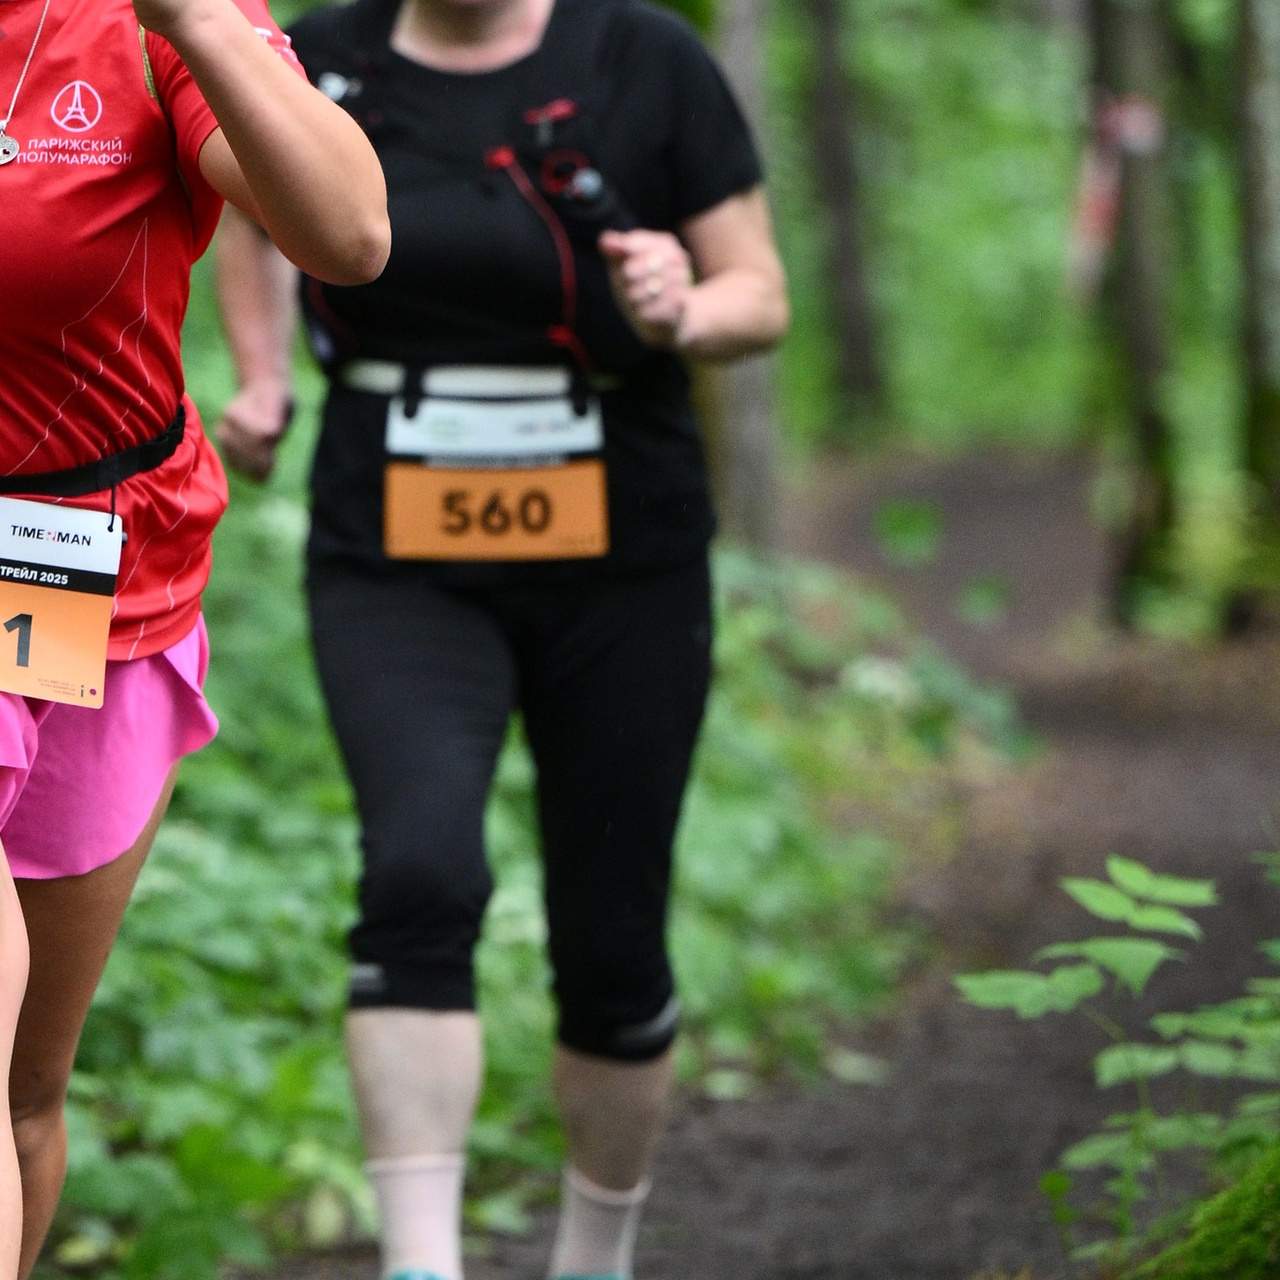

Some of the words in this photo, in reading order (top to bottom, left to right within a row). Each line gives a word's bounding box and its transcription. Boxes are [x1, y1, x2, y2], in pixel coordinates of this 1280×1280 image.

[28, 137, 122, 151] ПАРИЖСКИЙ
[17, 151, 132, 165] ПОЛУМАРАФОН
[440, 489, 552, 537] 560
[0, 565, 38, 581] ТРЕЙЛ
[39, 571, 68, 585] 2025
